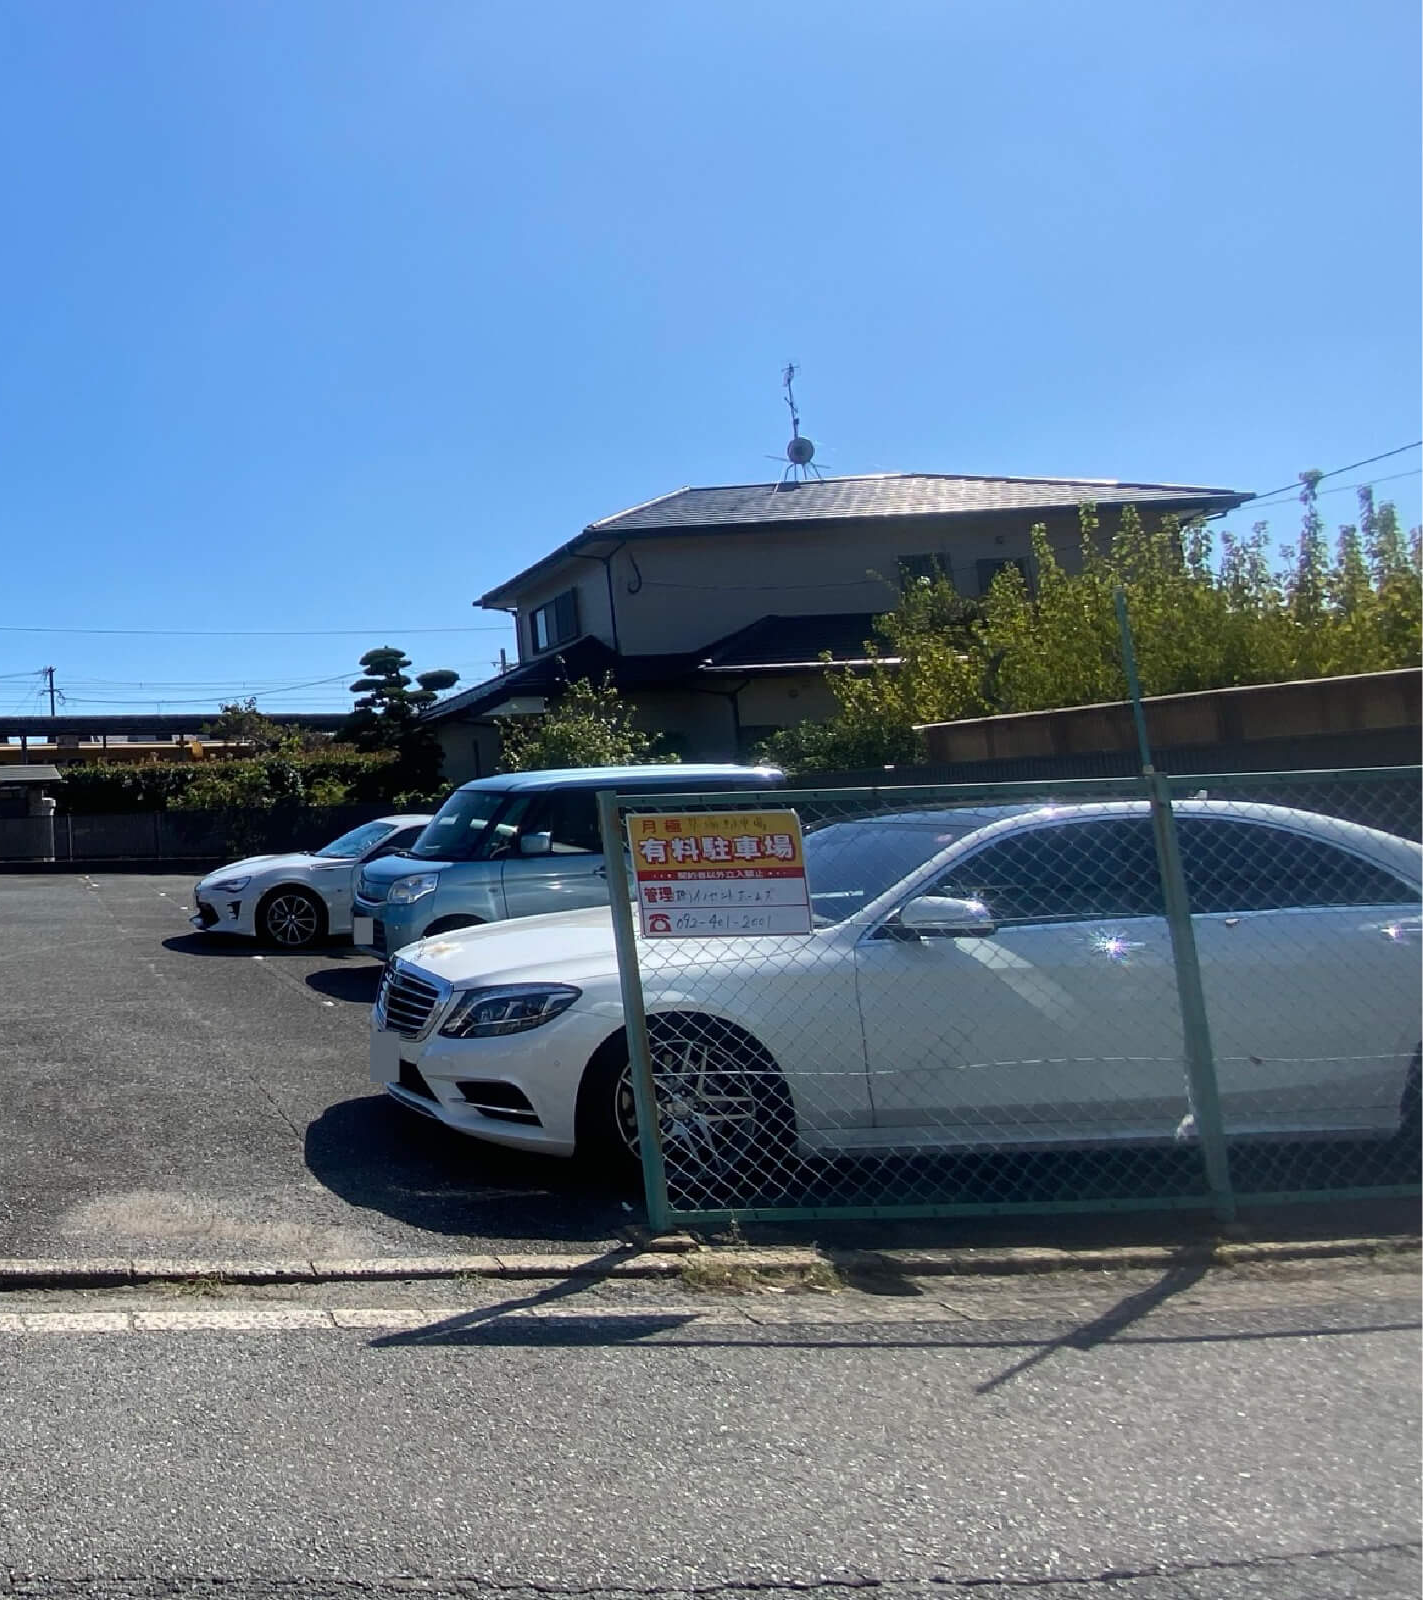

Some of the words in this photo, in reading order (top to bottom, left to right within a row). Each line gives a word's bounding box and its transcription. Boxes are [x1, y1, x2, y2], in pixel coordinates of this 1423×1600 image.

[639, 834, 795, 864] 有料駐車場
[644, 886, 674, 903] 管理
